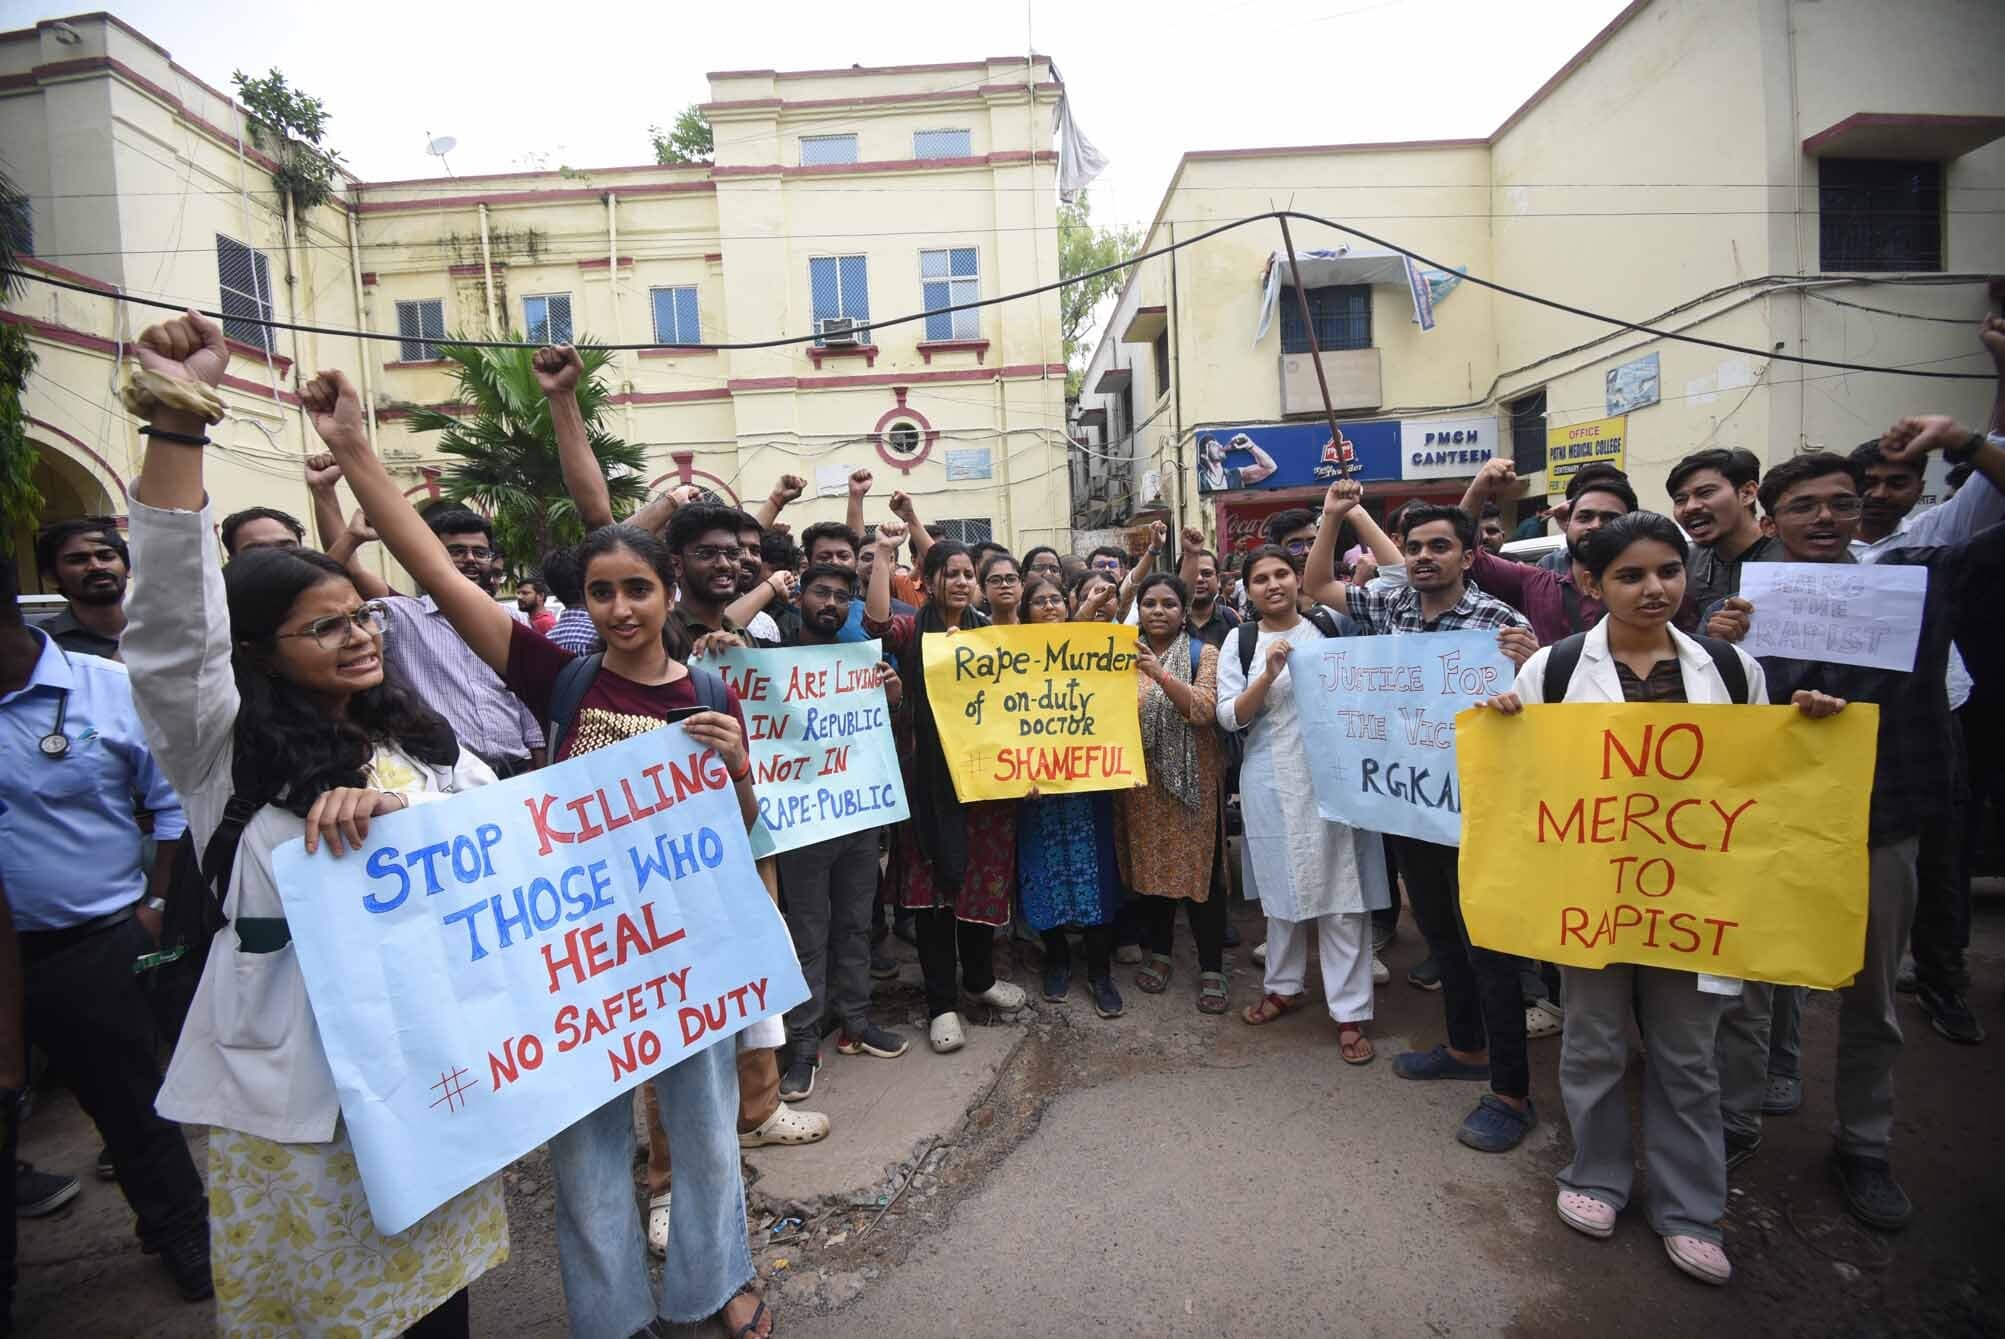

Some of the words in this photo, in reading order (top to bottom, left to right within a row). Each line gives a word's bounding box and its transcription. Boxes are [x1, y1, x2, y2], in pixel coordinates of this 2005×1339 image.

[1568, 426, 1600, 439] OFFICE
[1596, 437, 1621, 456] COLLEGE
[1411, 449, 1491, 466] CANTEEN
[719, 665, 770, 701] WE
[784, 665, 828, 703] ARE
[835, 660, 883, 694] LIVING
[1438, 650, 1502, 696] FOR
[751, 714, 791, 742] IN
[802, 706, 883, 742] REPUBLIC
[965, 690, 985, 725] of
[1004, 678, 1095, 721] on-duty
[1019, 715, 1096, 736] DOCTOR
[1337, 710, 1387, 741] THE
[1398, 707, 1456, 749] VIC
[758, 754, 811, 785] NOT
[817, 744, 850, 776] IN
[1600, 723, 1705, 781] NO
[363, 824, 501, 914] STOP
[524, 749, 729, 856] KILLING
[1537, 792, 1758, 853] MERCY
[444, 859, 614, 962] THOSE
[630, 826, 724, 894] WHO
[1609, 856, 1675, 897] TO
[541, 902, 685, 994] HEAL
[1559, 904, 1739, 956] RAPIST
[487, 1033, 544, 1092] NO
[554, 966, 692, 1053] SAFETY
[608, 1030, 662, 1082] NO
[679, 978, 768, 1047] DUTY
